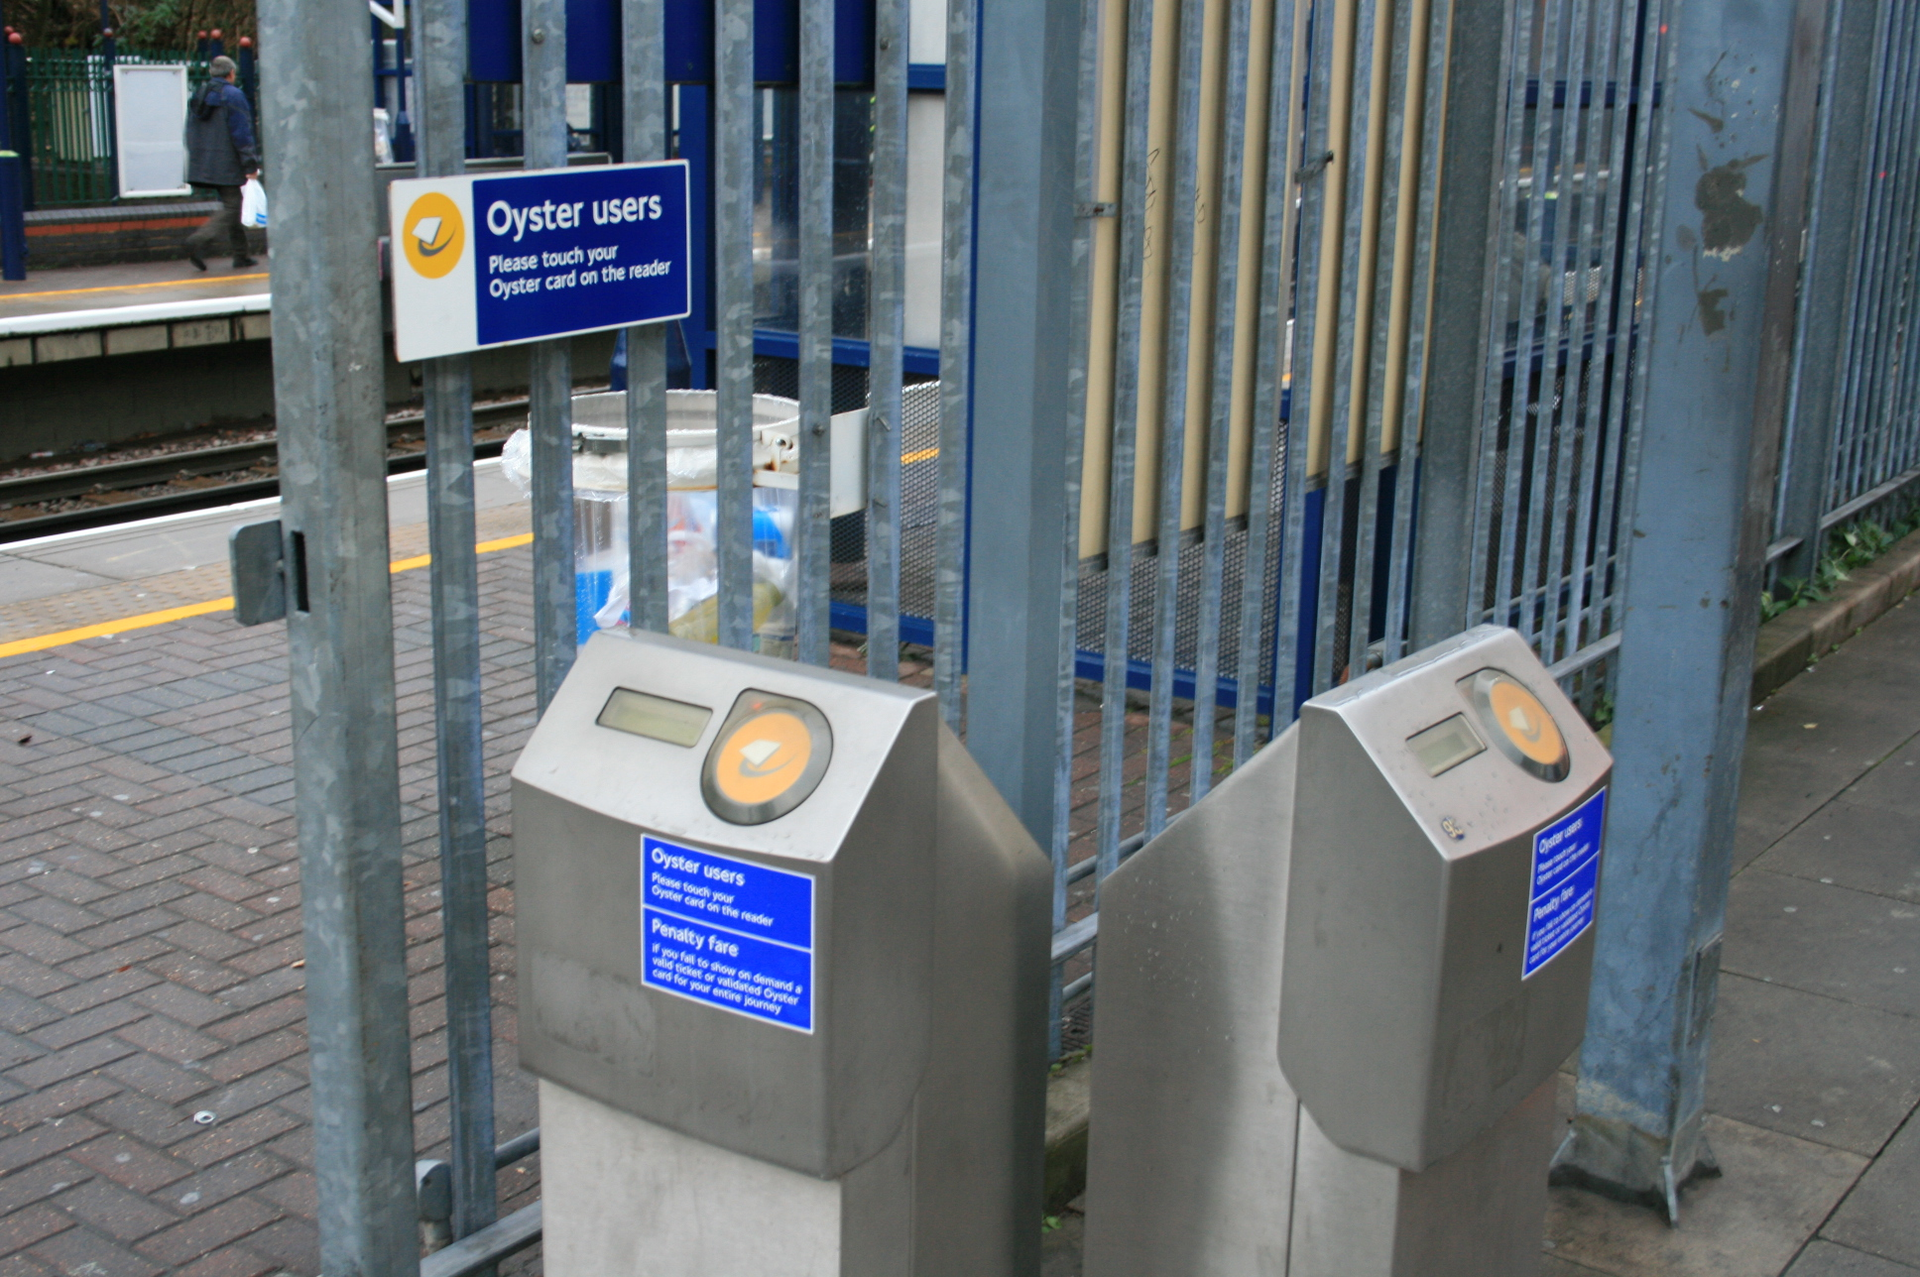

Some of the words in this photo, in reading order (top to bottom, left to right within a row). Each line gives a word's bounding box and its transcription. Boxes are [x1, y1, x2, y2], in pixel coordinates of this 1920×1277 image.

[487, 198, 584, 242] Oyster
[592, 194, 662, 225] users
[489, 254, 538, 275] Please
[542, 246, 584, 268] touch
[587, 244, 618, 266] your
[489, 278, 541, 301] Oyster
[545, 269, 576, 291] card
[580, 271, 599, 286] on
[602, 265, 625, 283] the
[629, 259, 672, 279] reader
[651, 847, 700, 874] Oyster
[704, 864, 746, 887] users
[651, 872, 681, 890] Please
[683, 879, 711, 898] touch
[712, 891, 735, 904] your
[651, 884, 683, 904] Oyster
[685, 894, 705, 909] card
[707, 902, 720, 913] on
[722, 904, 740, 919] the
[741, 911, 775, 927] reader
[651, 917, 705, 950] Penalty
[708, 933, 739, 958] fare
[652, 955, 674, 972] valid
[675, 962, 703, 980] ticket
[704, 971, 715, 982] or
[717, 975, 761, 996] validated
[764, 985, 800, 1006] Oyster
[662, 946, 680, 961] you
[680, 950, 696, 965] fail
[697, 957, 709, 969] to
[710, 959, 736, 976] show
[738, 969, 752, 981] on
[753, 972, 793, 993] demand
[795, 984, 803, 995] a
[652, 969, 673, 982] card
[674, 974, 689, 987] for
[689, 979, 711, 994] your
[712, 985, 742, 1003] entire
[744, 994, 782, 1016] journey
